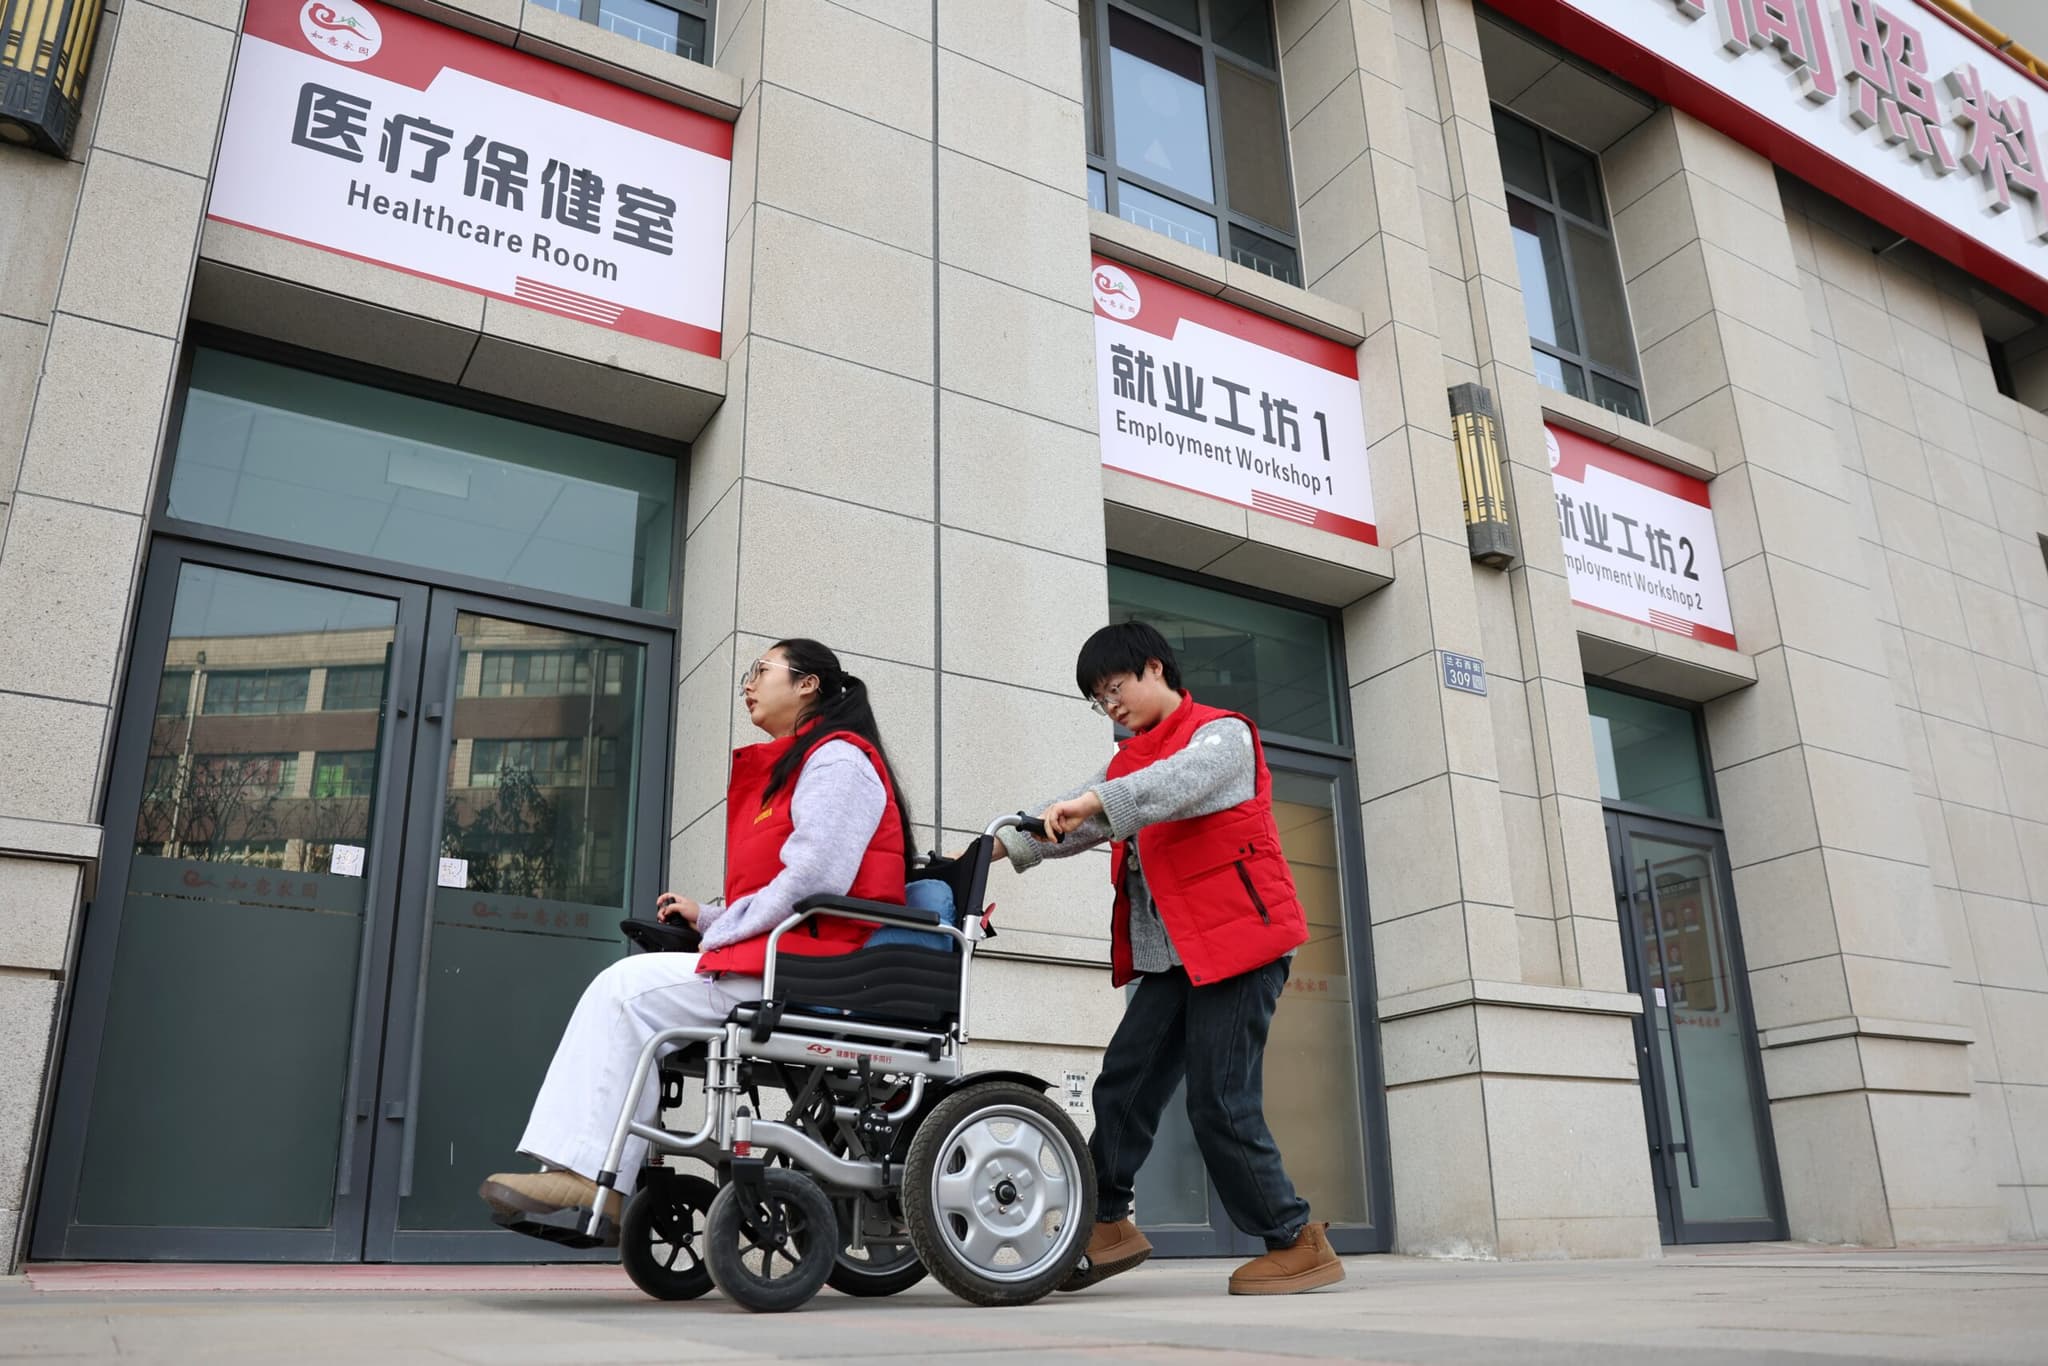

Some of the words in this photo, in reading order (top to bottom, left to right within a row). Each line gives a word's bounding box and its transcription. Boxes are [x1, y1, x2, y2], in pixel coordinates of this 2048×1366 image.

[291, 82, 677, 256] 医疗保健室
[347, 180, 523, 254] Healthcare
[531, 233, 618, 282] Room
[1116, 409, 1232, 465] Employment
[1235, 446, 1321, 496] Workshop
[1325, 476, 1334, 496] 1
[1564, 553, 1633, 588] mployment
[1633, 571, 1694, 610] Workshop
[1694, 592, 1704, 611] 2
[1449, 669, 1471, 687] 309
